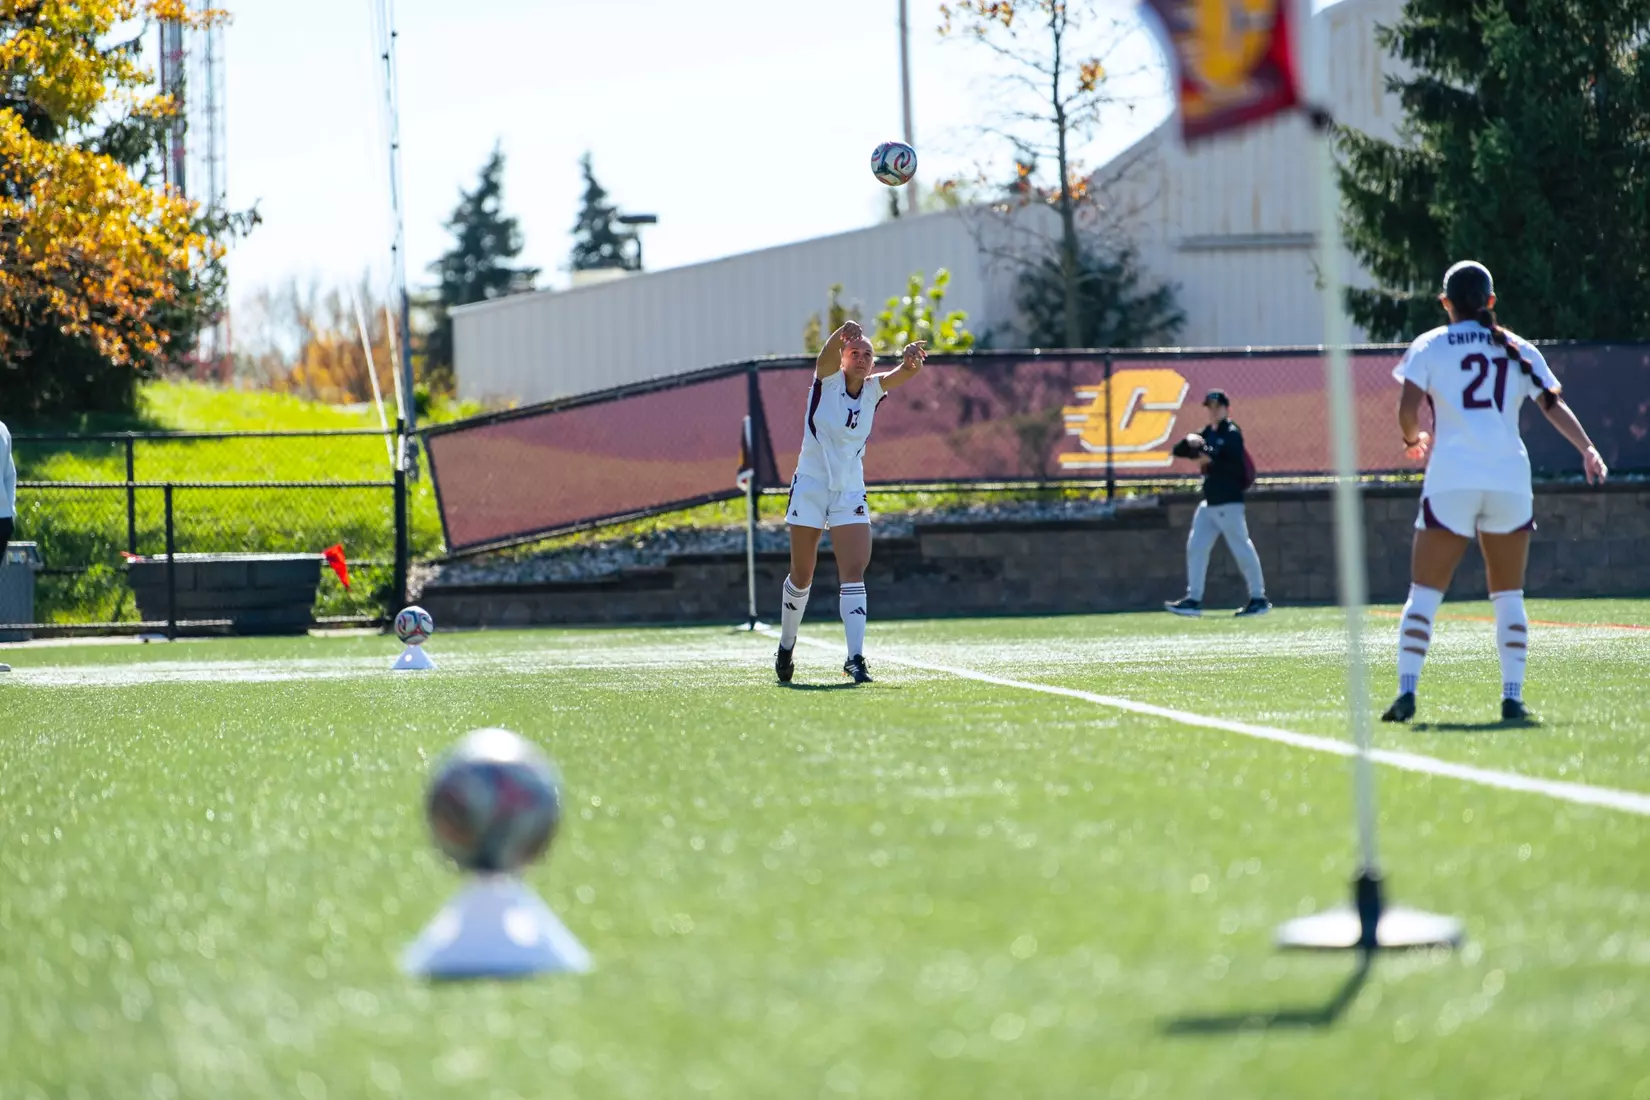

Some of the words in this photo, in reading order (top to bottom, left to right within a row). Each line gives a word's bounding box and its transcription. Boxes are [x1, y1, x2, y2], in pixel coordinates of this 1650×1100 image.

[1448, 331, 1493, 346] CHIPPE
[1460, 353, 1509, 413] 21
[844, 408, 862, 430] 13
[1062, 369, 1190, 453] C
